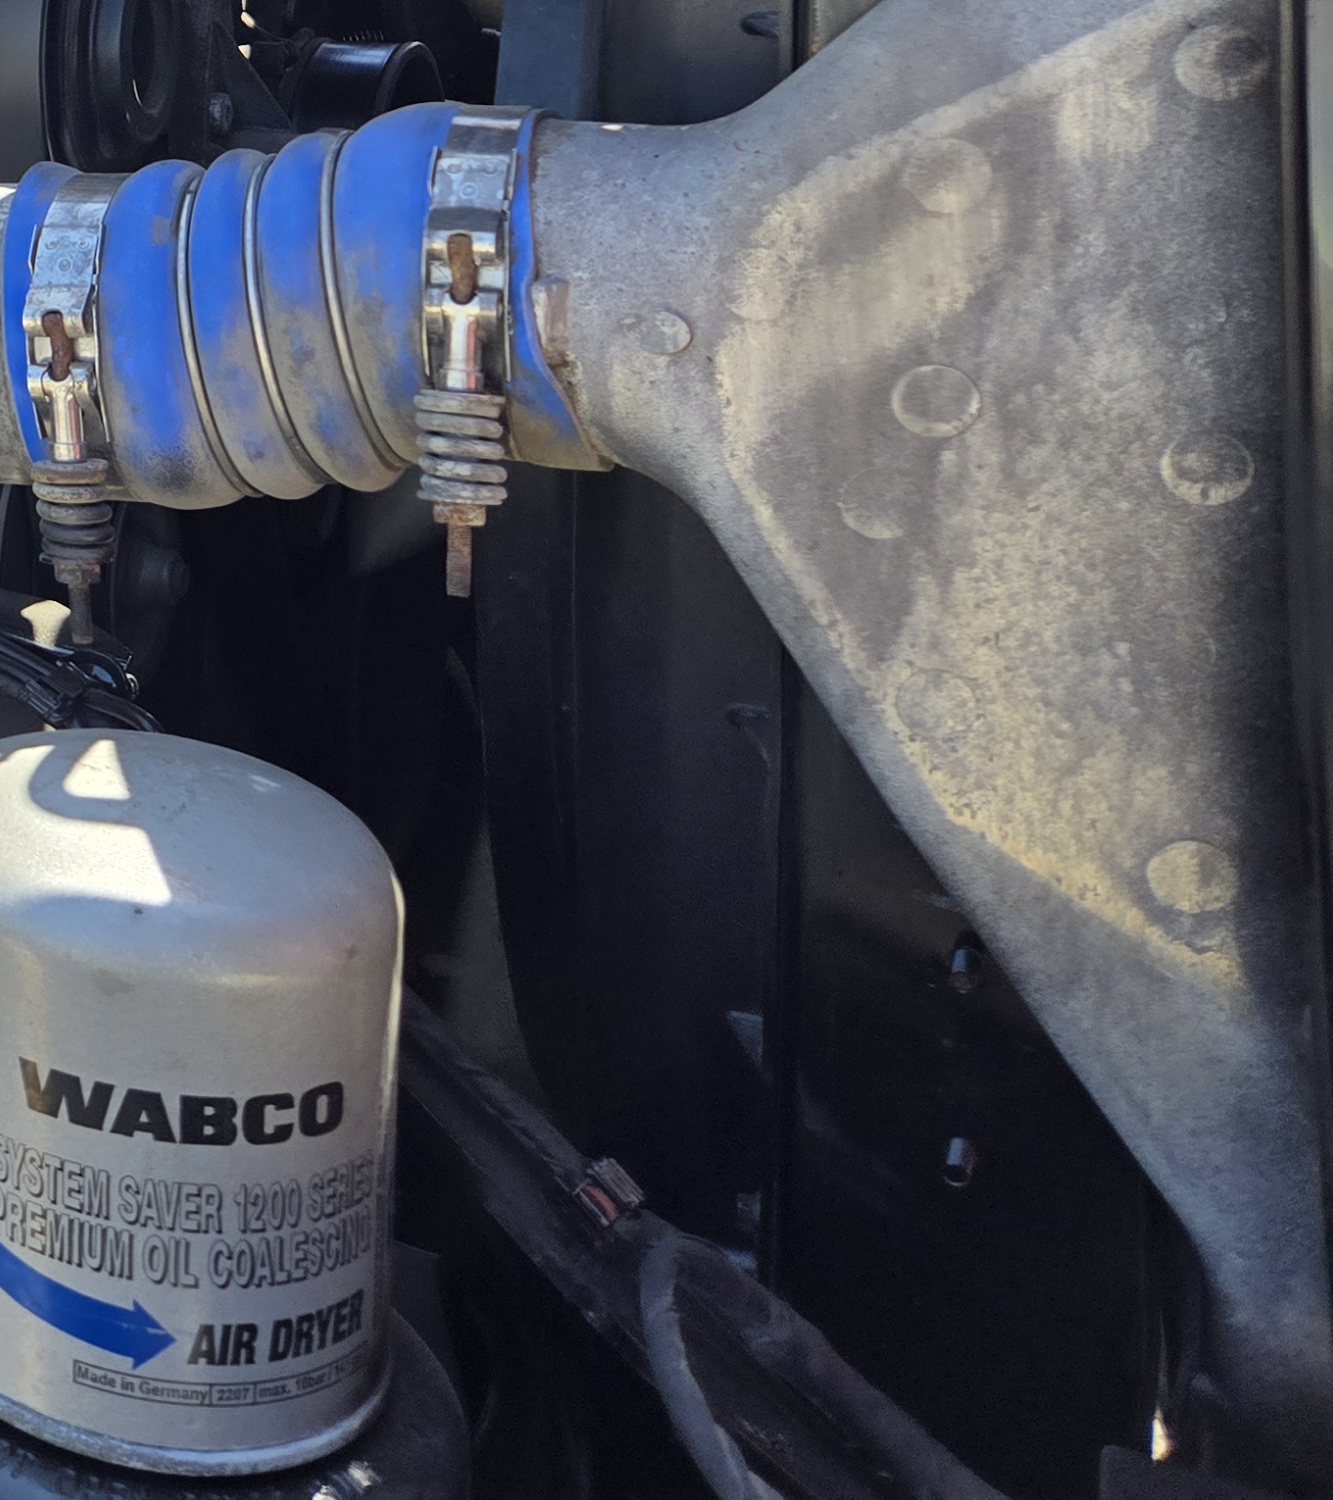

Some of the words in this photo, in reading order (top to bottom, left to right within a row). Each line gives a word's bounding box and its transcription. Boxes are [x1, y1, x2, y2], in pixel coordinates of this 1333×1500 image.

[19, 1055, 344, 1146] WABCO
[117, 1175, 222, 1234] SAVER
[235, 1177, 302, 1234] 1200
[307, 1149, 376, 1223] SERIES
[143, 1234, 199, 1289] OIL
[208, 1204, 376, 1289] COALESCING
[187, 1323, 259, 1366] AIR
[268, 1288, 364, 1362] DRYER
[76, 1365, 117, 1389] Made
[119, 1375, 135, 1391] in
[137, 1380, 209, 1404] Germany
